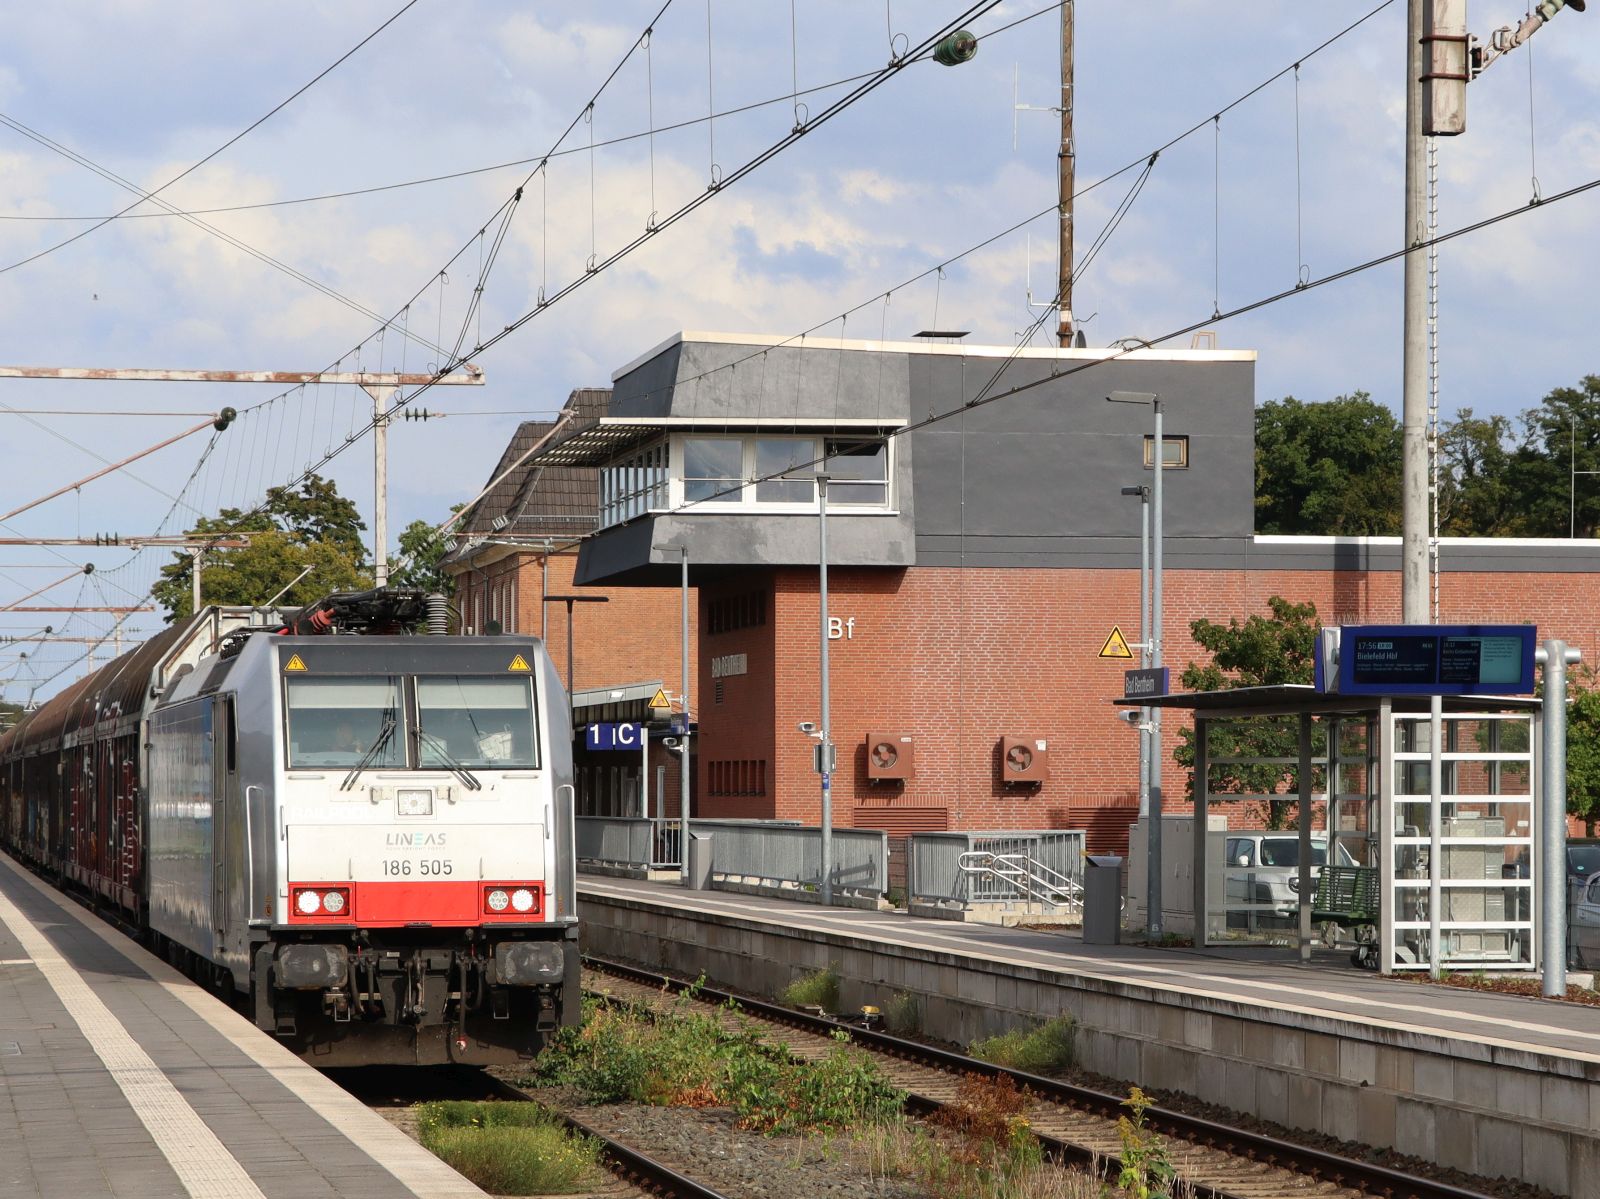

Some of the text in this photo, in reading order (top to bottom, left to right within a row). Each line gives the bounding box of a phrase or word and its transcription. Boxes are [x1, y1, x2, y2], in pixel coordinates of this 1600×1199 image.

[828, 617, 854, 639] Bf
[1358, 642, 1377, 650] 17:56
[1357, 652, 1398, 660] Bielefeld Hbf
[1126, 675, 1155, 693] Bad Bentheim
[590, 723, 634, 745] 1 C
[385, 832, 447, 846] LINEAS
[382, 859, 453, 876] 186 505
